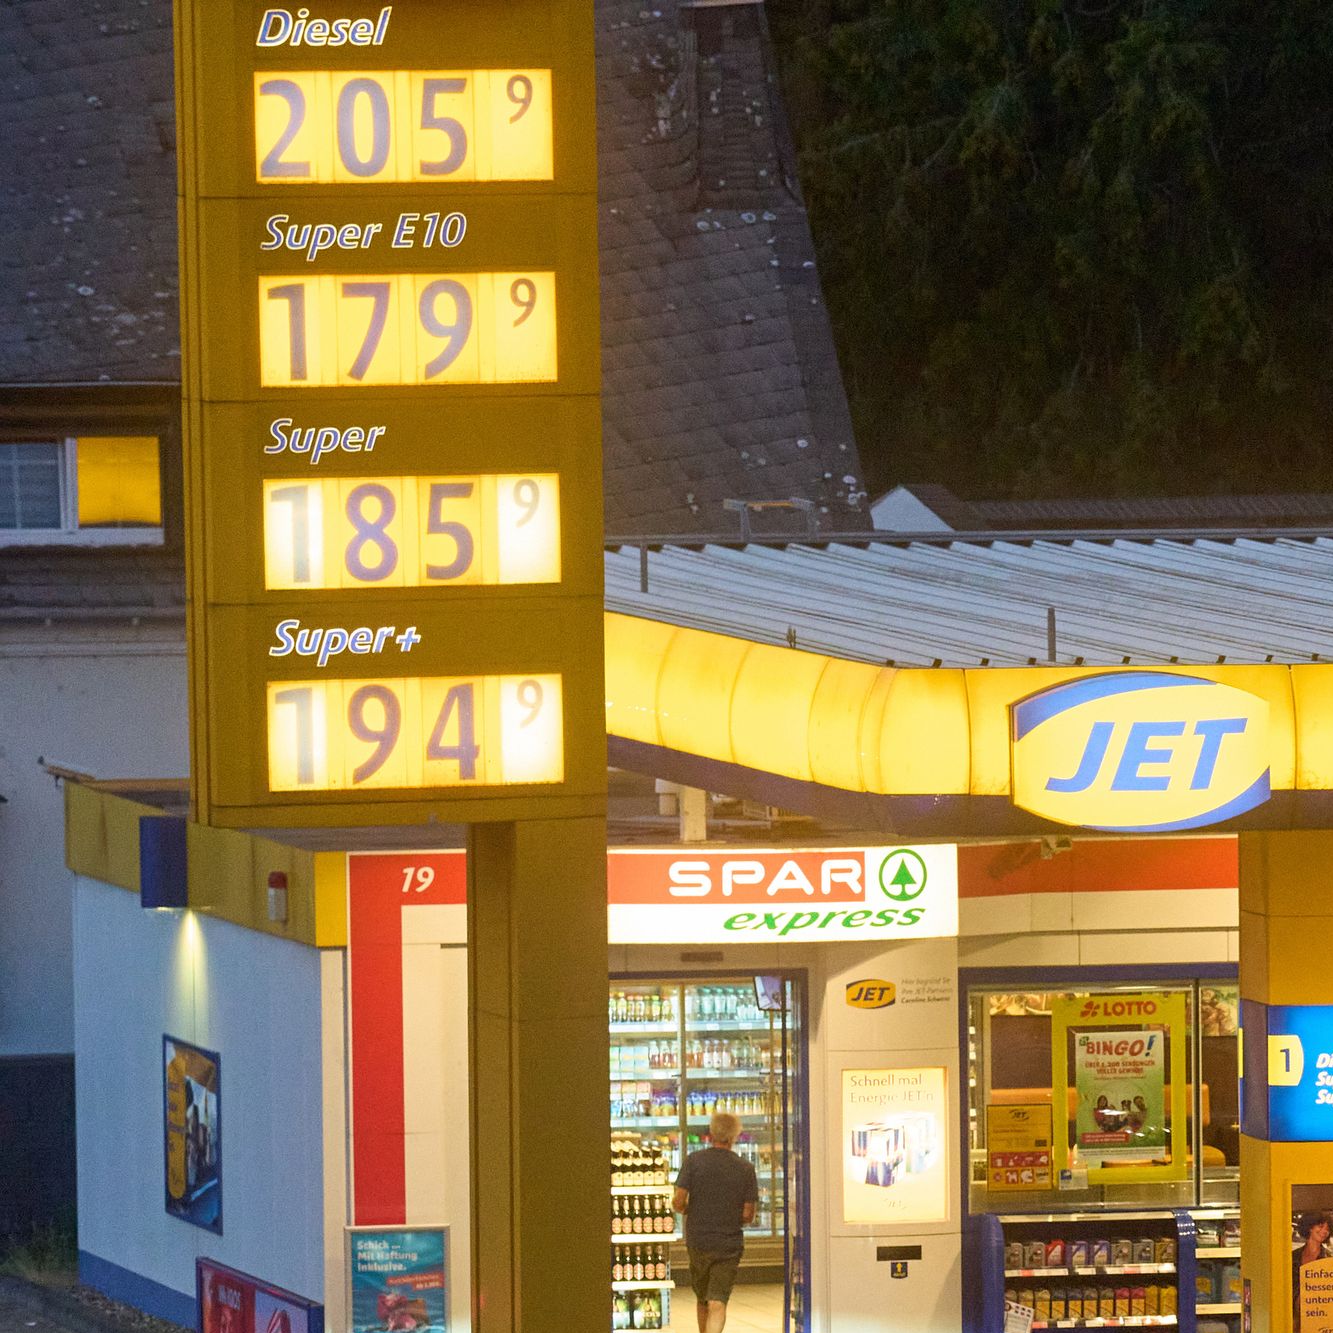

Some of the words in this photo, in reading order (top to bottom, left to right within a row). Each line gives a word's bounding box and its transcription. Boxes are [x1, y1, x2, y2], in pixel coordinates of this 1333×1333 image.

[256, 7, 392, 46] Diesel
[260, 214, 383, 261] Super
[391, 212, 467, 248] E10
[264, 418, 385, 464] Super
[269, 619, 421, 666] Super+
[1044, 718, 1249, 793] JET
[400, 865, 435, 893] 19
[668, 858, 862, 896] SPAR
[723, 905, 926, 937] express
[851, 987, 891, 1001] JET
[1103, 1001, 1157, 1017] LOTTO
[1086, 1034, 1157, 1057] BINGO!
[1280, 1048, 1290, 1072] 1
[850, 1075, 895, 1087] Schnell
[898, 1074, 922, 1086] mal
[850, 1091, 897, 1106] Energie
[357, 1240, 389, 1250] Schick
[1305, 1308, 1328, 1318] sein.
